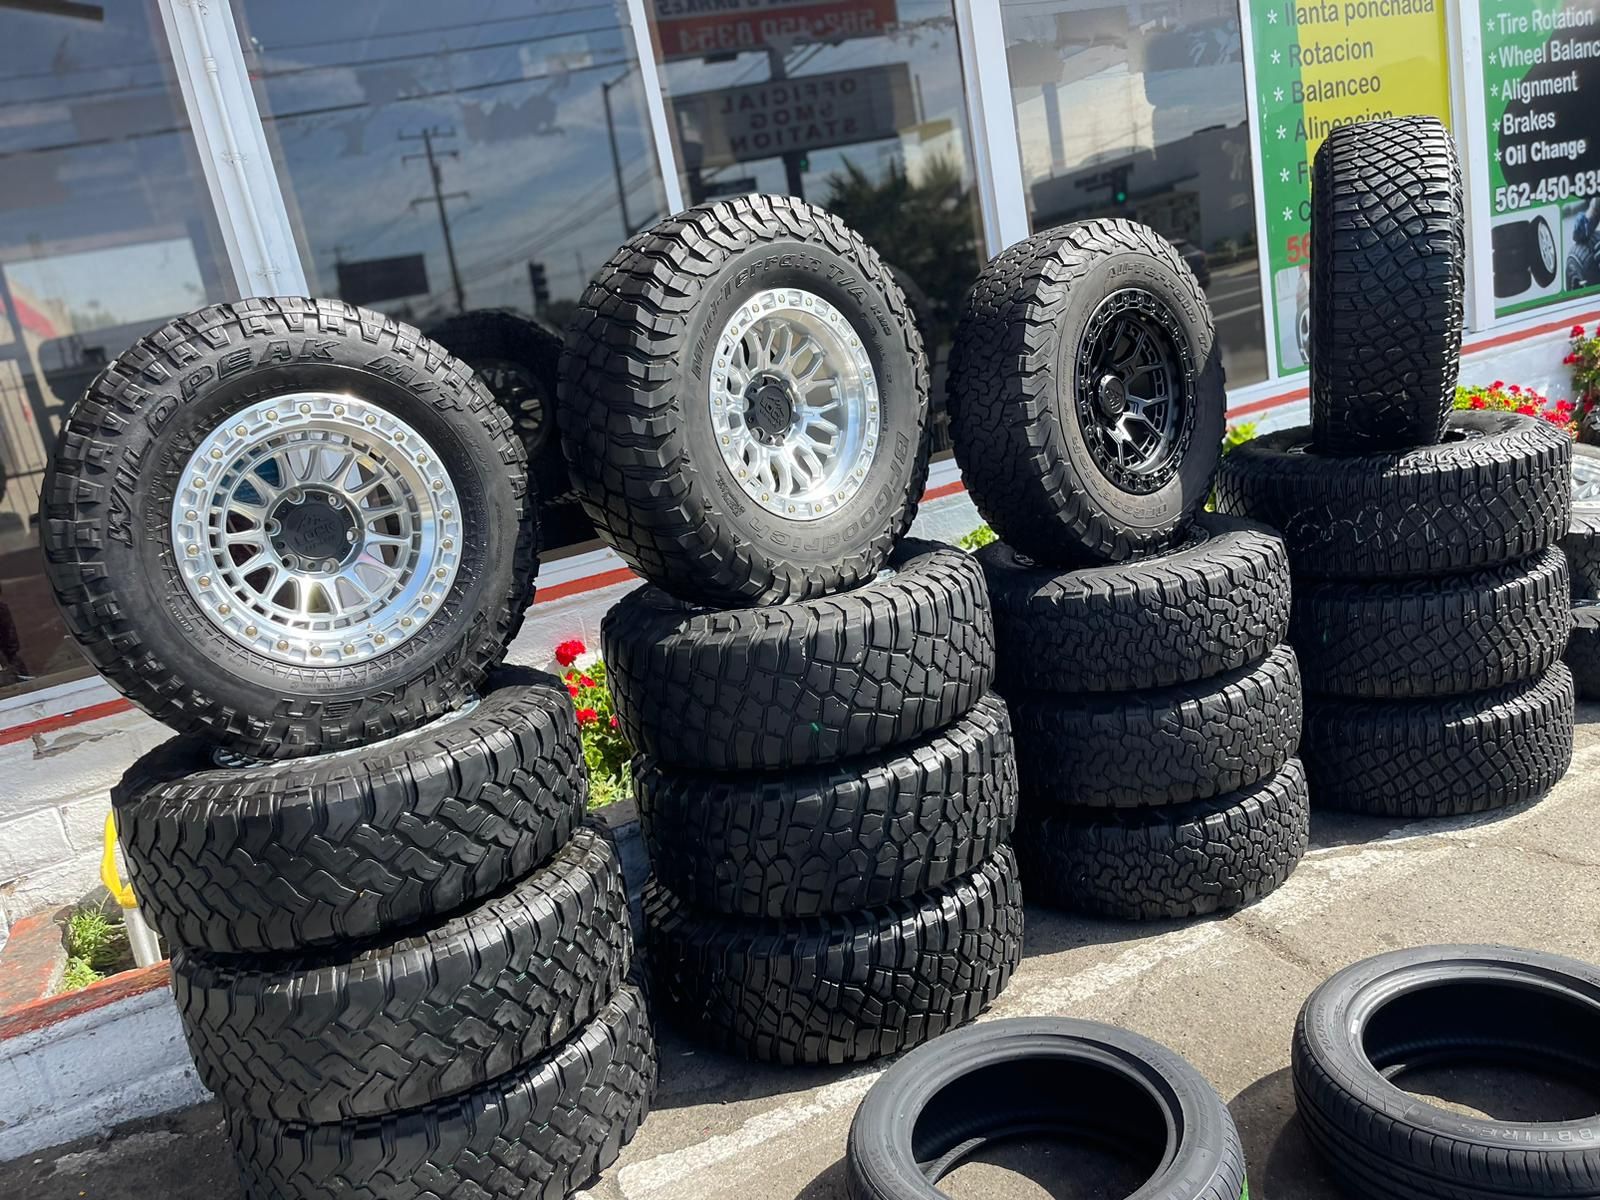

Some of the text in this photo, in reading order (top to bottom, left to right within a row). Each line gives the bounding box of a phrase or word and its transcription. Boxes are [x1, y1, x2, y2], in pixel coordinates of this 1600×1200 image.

[1285, 0, 1434, 26] llanta ponchada
[1497, 6, 1594, 35] Tire Rotation
[1289, 38, 1374, 68] Rotacion
[1498, 38, 1600, 69] Wheel Balanc
[1292, 75, 1381, 105] Balanceo
[1501, 70, 1579, 104] Alignment
[1503, 110, 1556, 135] Brakes
[1505, 139, 1586, 166] Oil Change
[691, 252, 822, 381] Mud-Terrain
[829, 263, 870, 306] T/A
[363, 355, 465, 413] M/T
[749, 431, 910, 554] BFGoodrich
